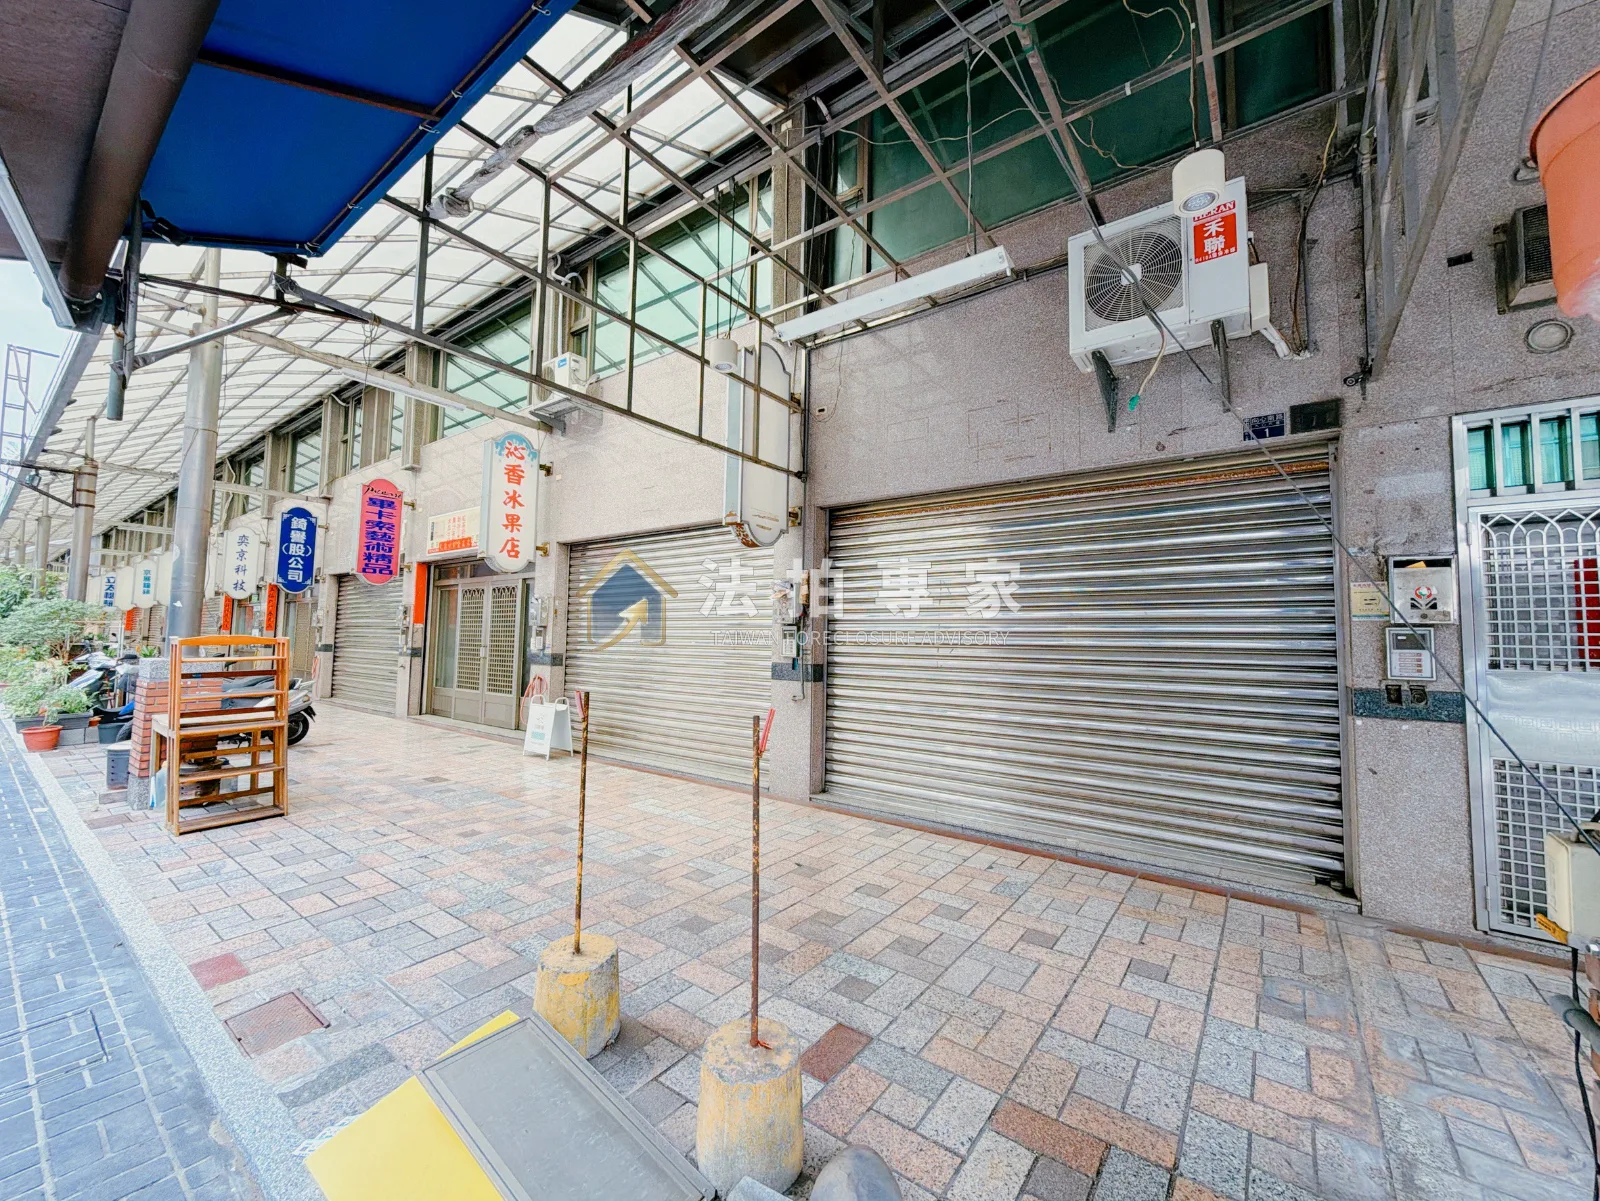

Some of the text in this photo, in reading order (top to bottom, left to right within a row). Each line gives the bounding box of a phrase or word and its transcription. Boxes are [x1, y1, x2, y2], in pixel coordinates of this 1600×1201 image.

[1203, 218, 1226, 254] 禾聯
[1264, 427, 1270, 438] 1
[499, 440, 526, 559] 沁香冰果店
[233, 534, 250, 592] 奕京科技
[362, 497, 397, 576] 畢卡索藝術精品
